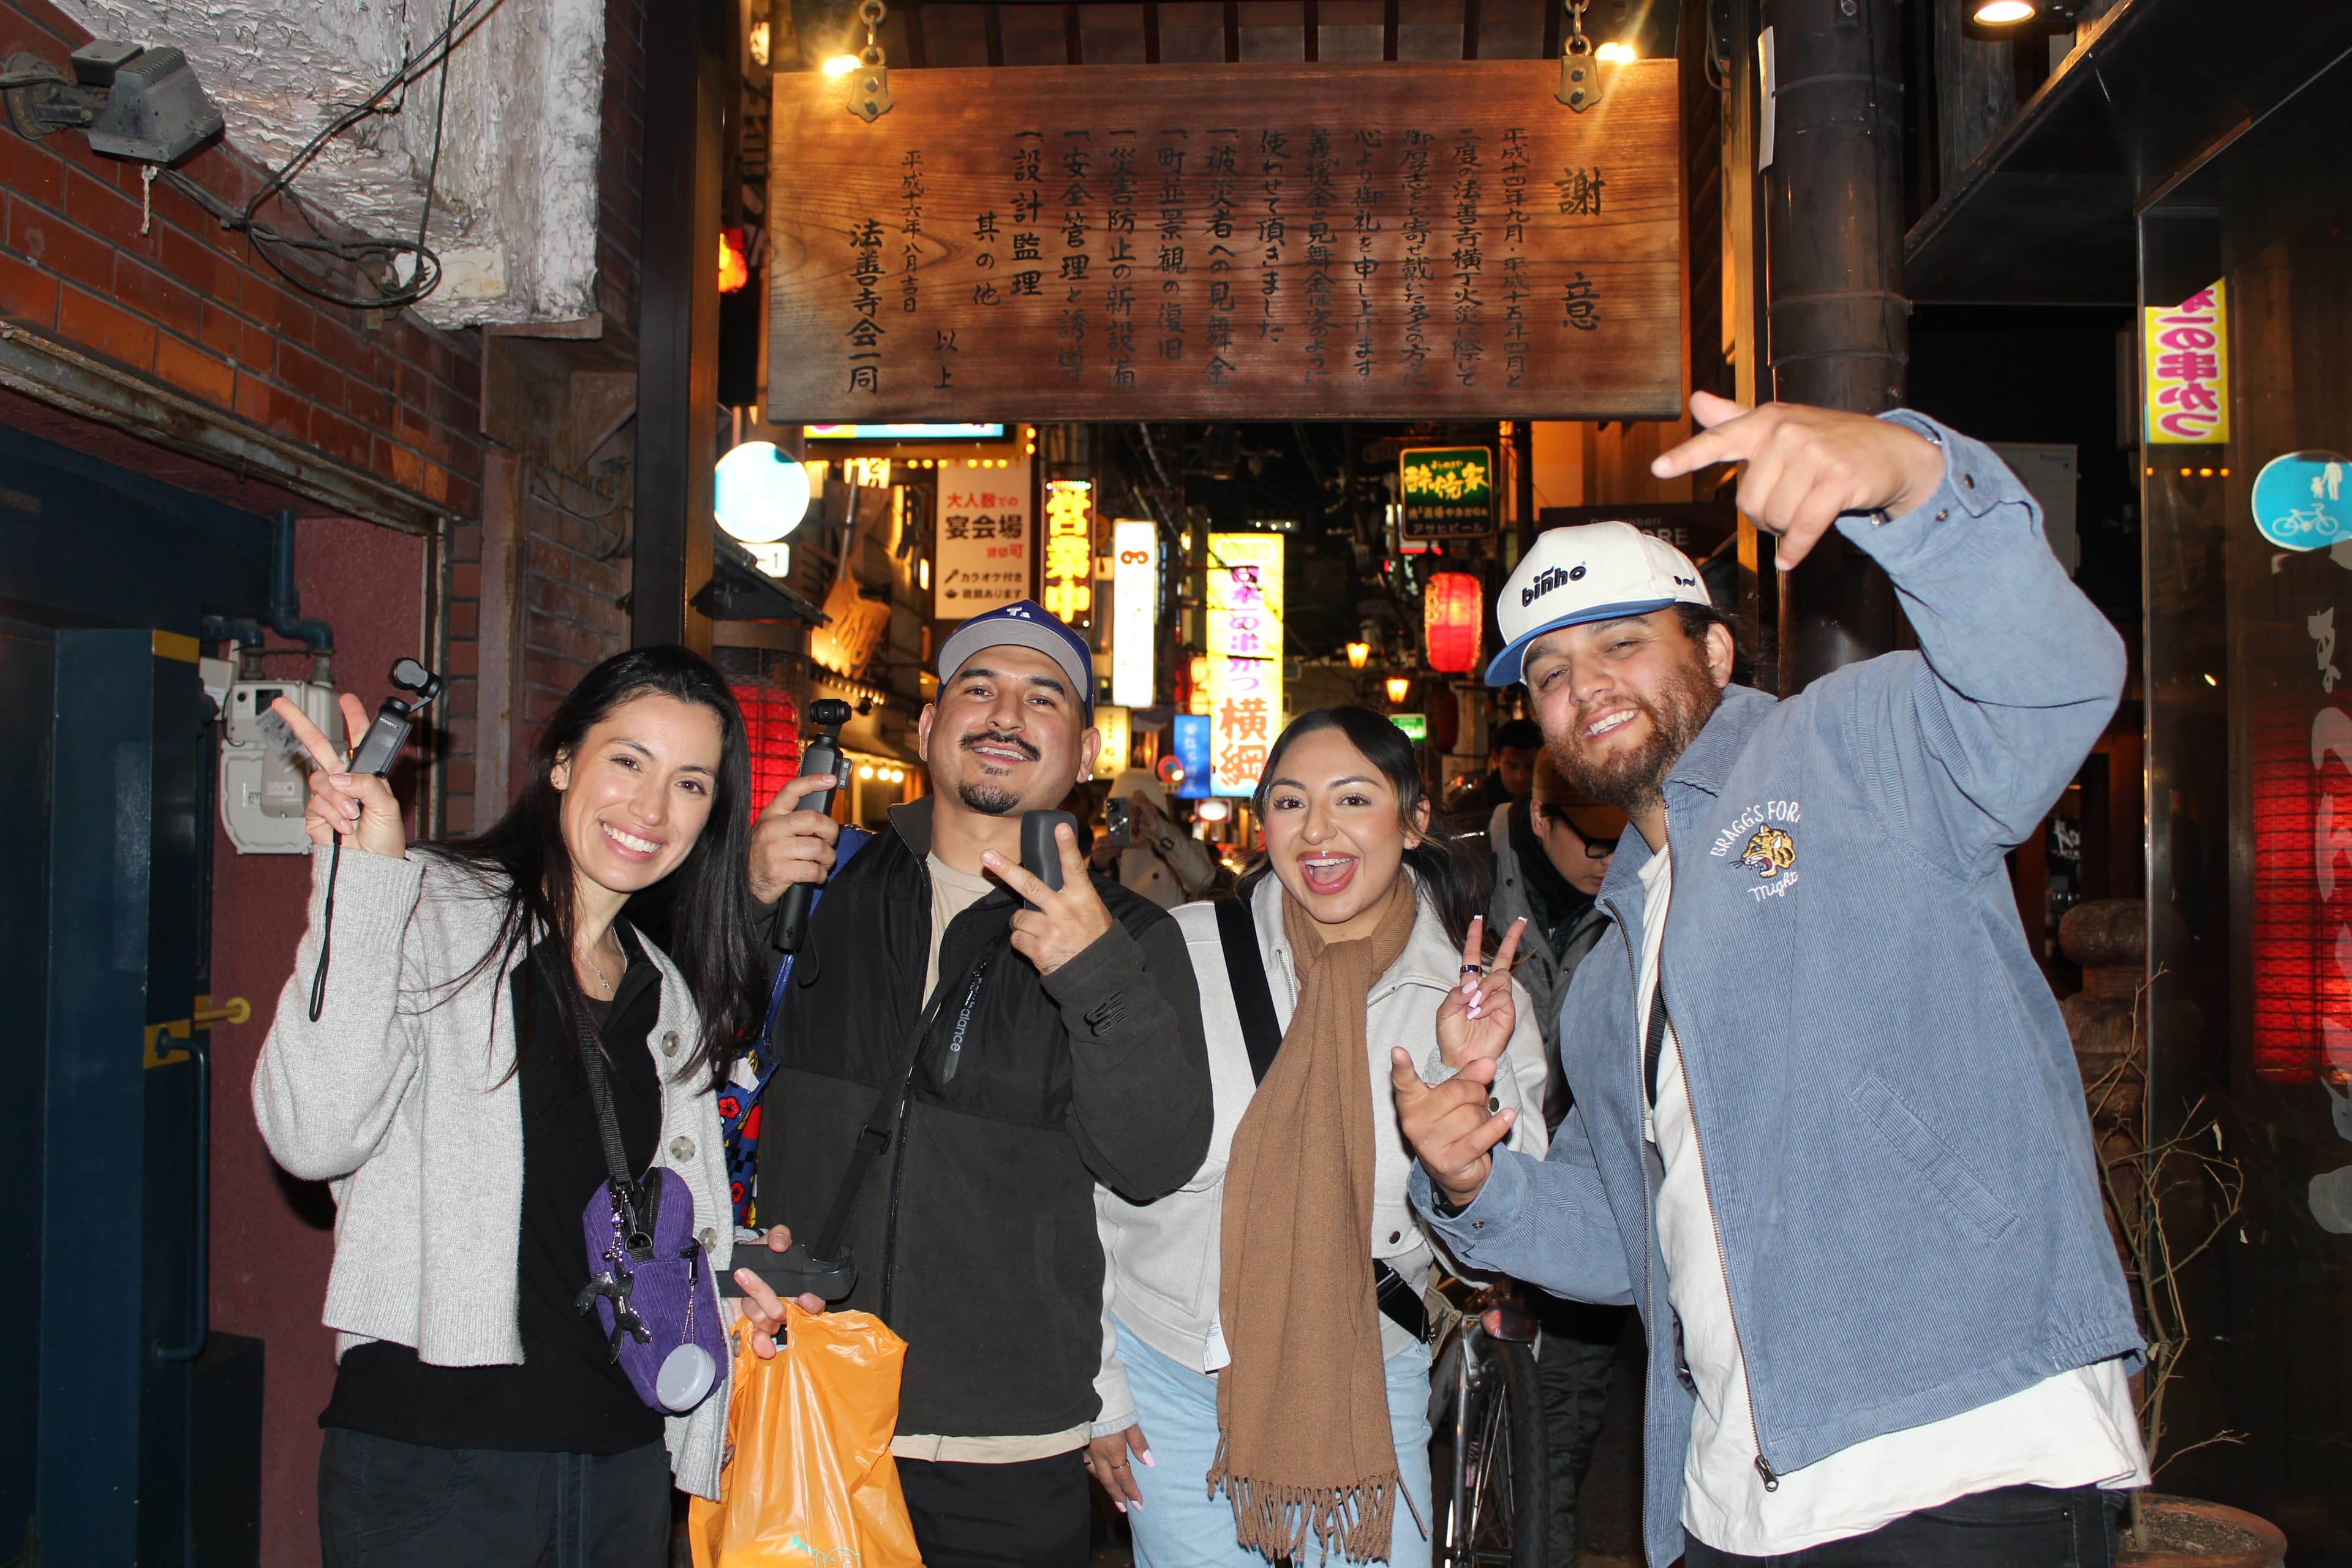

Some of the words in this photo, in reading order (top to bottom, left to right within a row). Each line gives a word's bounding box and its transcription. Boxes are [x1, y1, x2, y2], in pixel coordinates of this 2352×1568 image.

[1555, 167, 1606, 332] 謝意
[845, 218, 886, 396] 法善寺会一同
[933, 328, 959, 390] 以上
[945, 513, 1022, 540] 宴会場
[947, 492, 1019, 508] 大人数での
[1045, 489, 1091, 624] 営業中
[1219, 697, 1269, 786] 横綱
[1709, 804, 1765, 858] BRAGG'S
